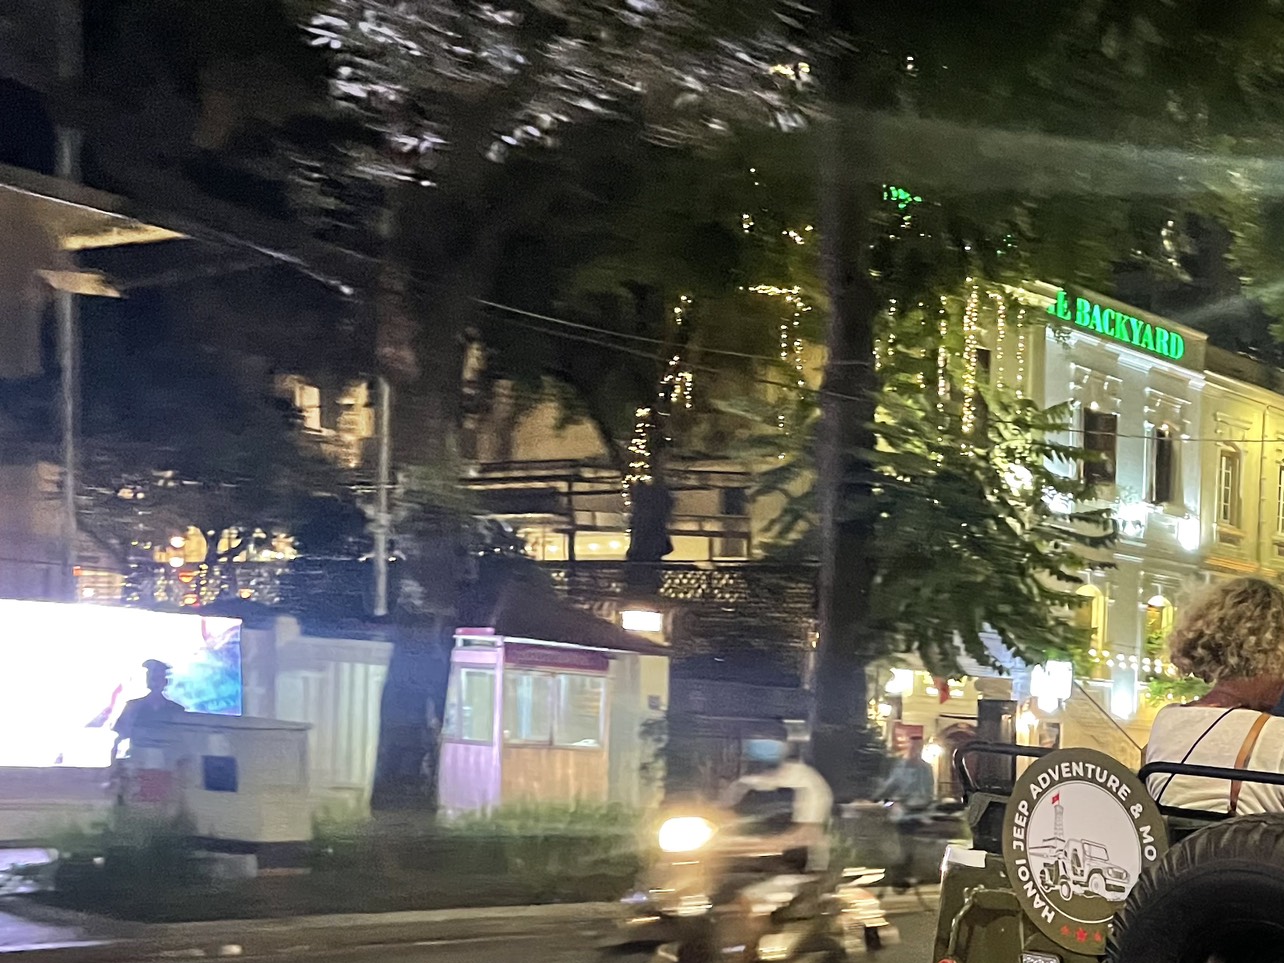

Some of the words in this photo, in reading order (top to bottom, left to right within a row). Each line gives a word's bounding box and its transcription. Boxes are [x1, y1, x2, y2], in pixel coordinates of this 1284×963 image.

[1075, 298, 1184, 360] BACKYARD
[1029, 761, 1131, 801] ADVENTURE
[1013, 800, 1030, 851] JEEP
[1130, 803, 1143, 819] &
[1139, 825, 1157, 862] MO
[1015, 859, 1055, 923] HANOI
